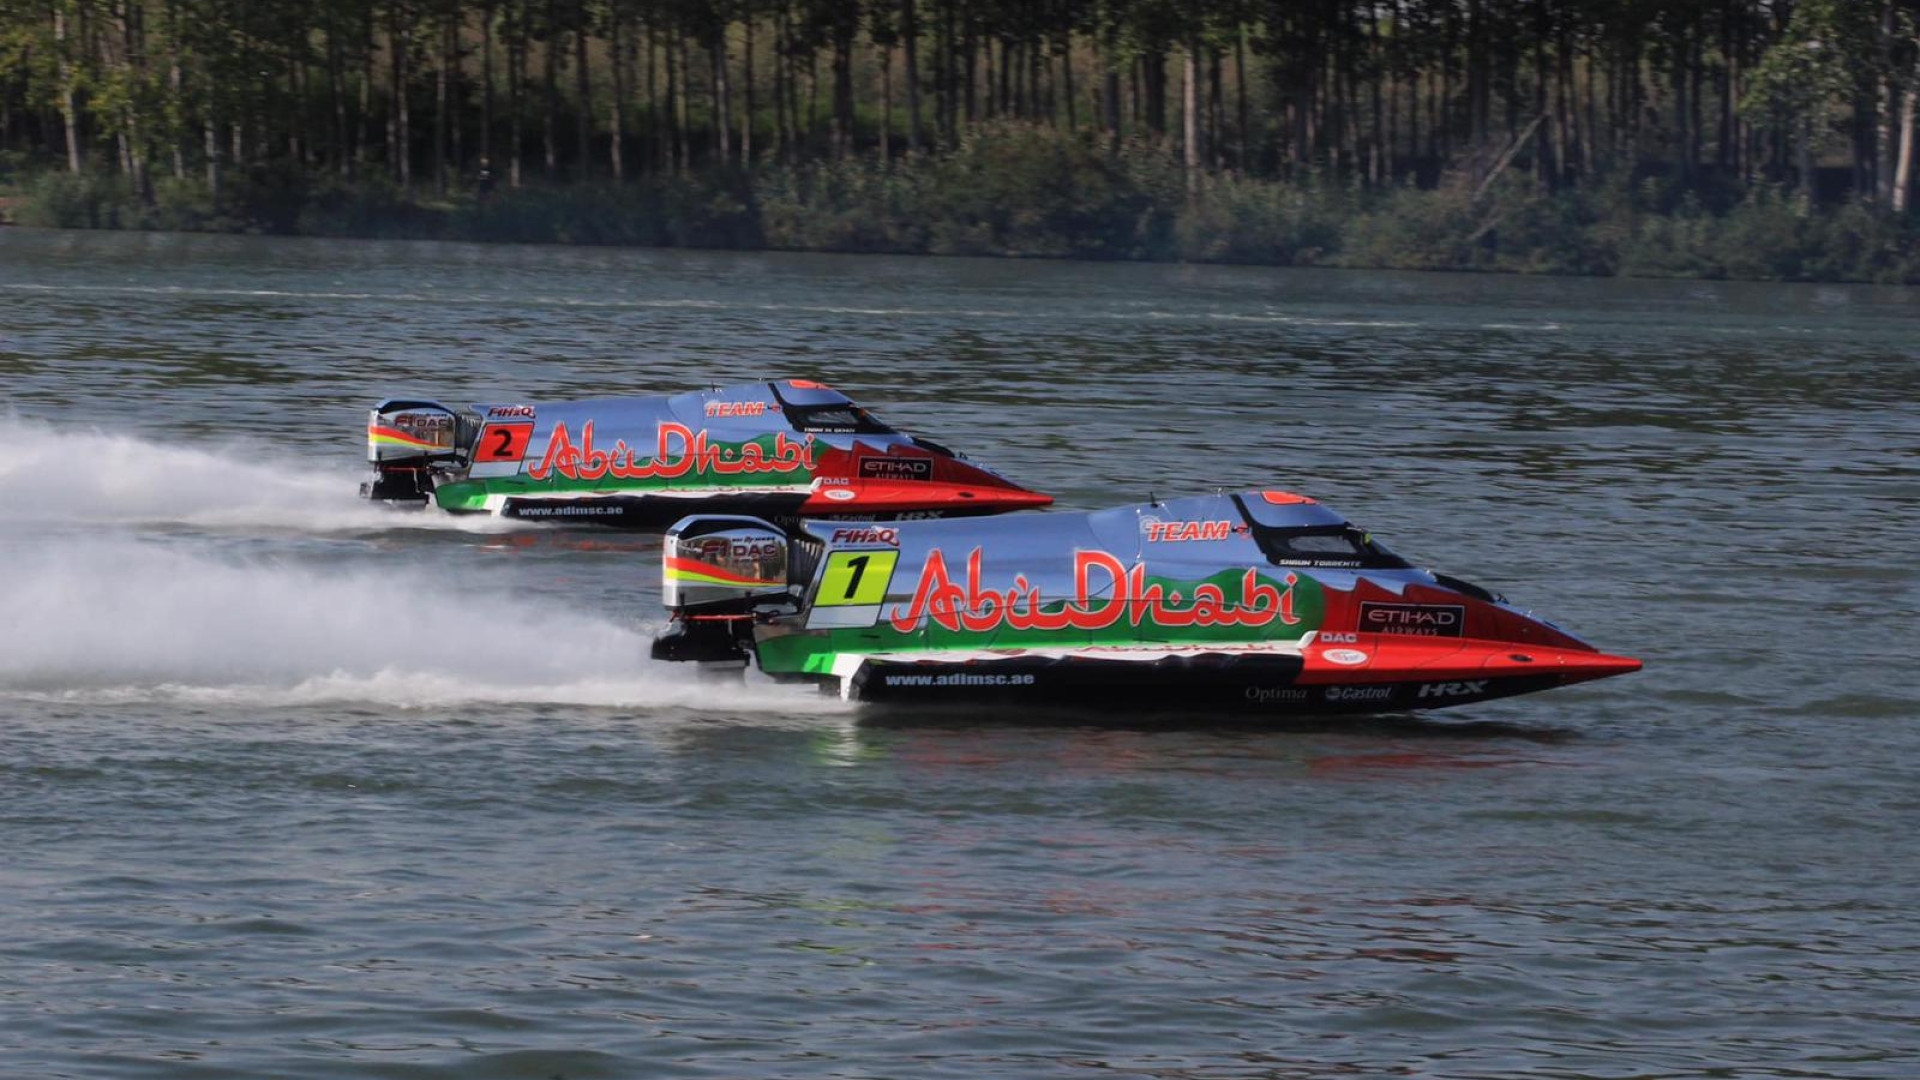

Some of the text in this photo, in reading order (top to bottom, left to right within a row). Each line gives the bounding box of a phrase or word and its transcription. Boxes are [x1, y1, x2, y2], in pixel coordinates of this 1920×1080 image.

[705, 401, 764, 417] TEAM
[492, 429, 513, 457] 2
[657, 421, 817, 479] Dhabi
[864, 461, 927, 473] ETIHAD
[823, 477, 849, 485] DAC
[518, 506, 624, 516] www.adimsc.ae
[1146, 520, 1231, 542] TEAM
[733, 543, 776, 557] DAC
[844, 555, 870, 599] 1
[1073, 549, 1300, 630] Dhabi
[1367, 609, 1455, 625] ETIHAD
[1320, 632, 1357, 643] DAC
[1381, 625, 1438, 636] AIRWAYS
[885, 673, 1034, 686] www.adimsc.ae
[1245, 680, 1487, 702] Optima Castrol HRX
